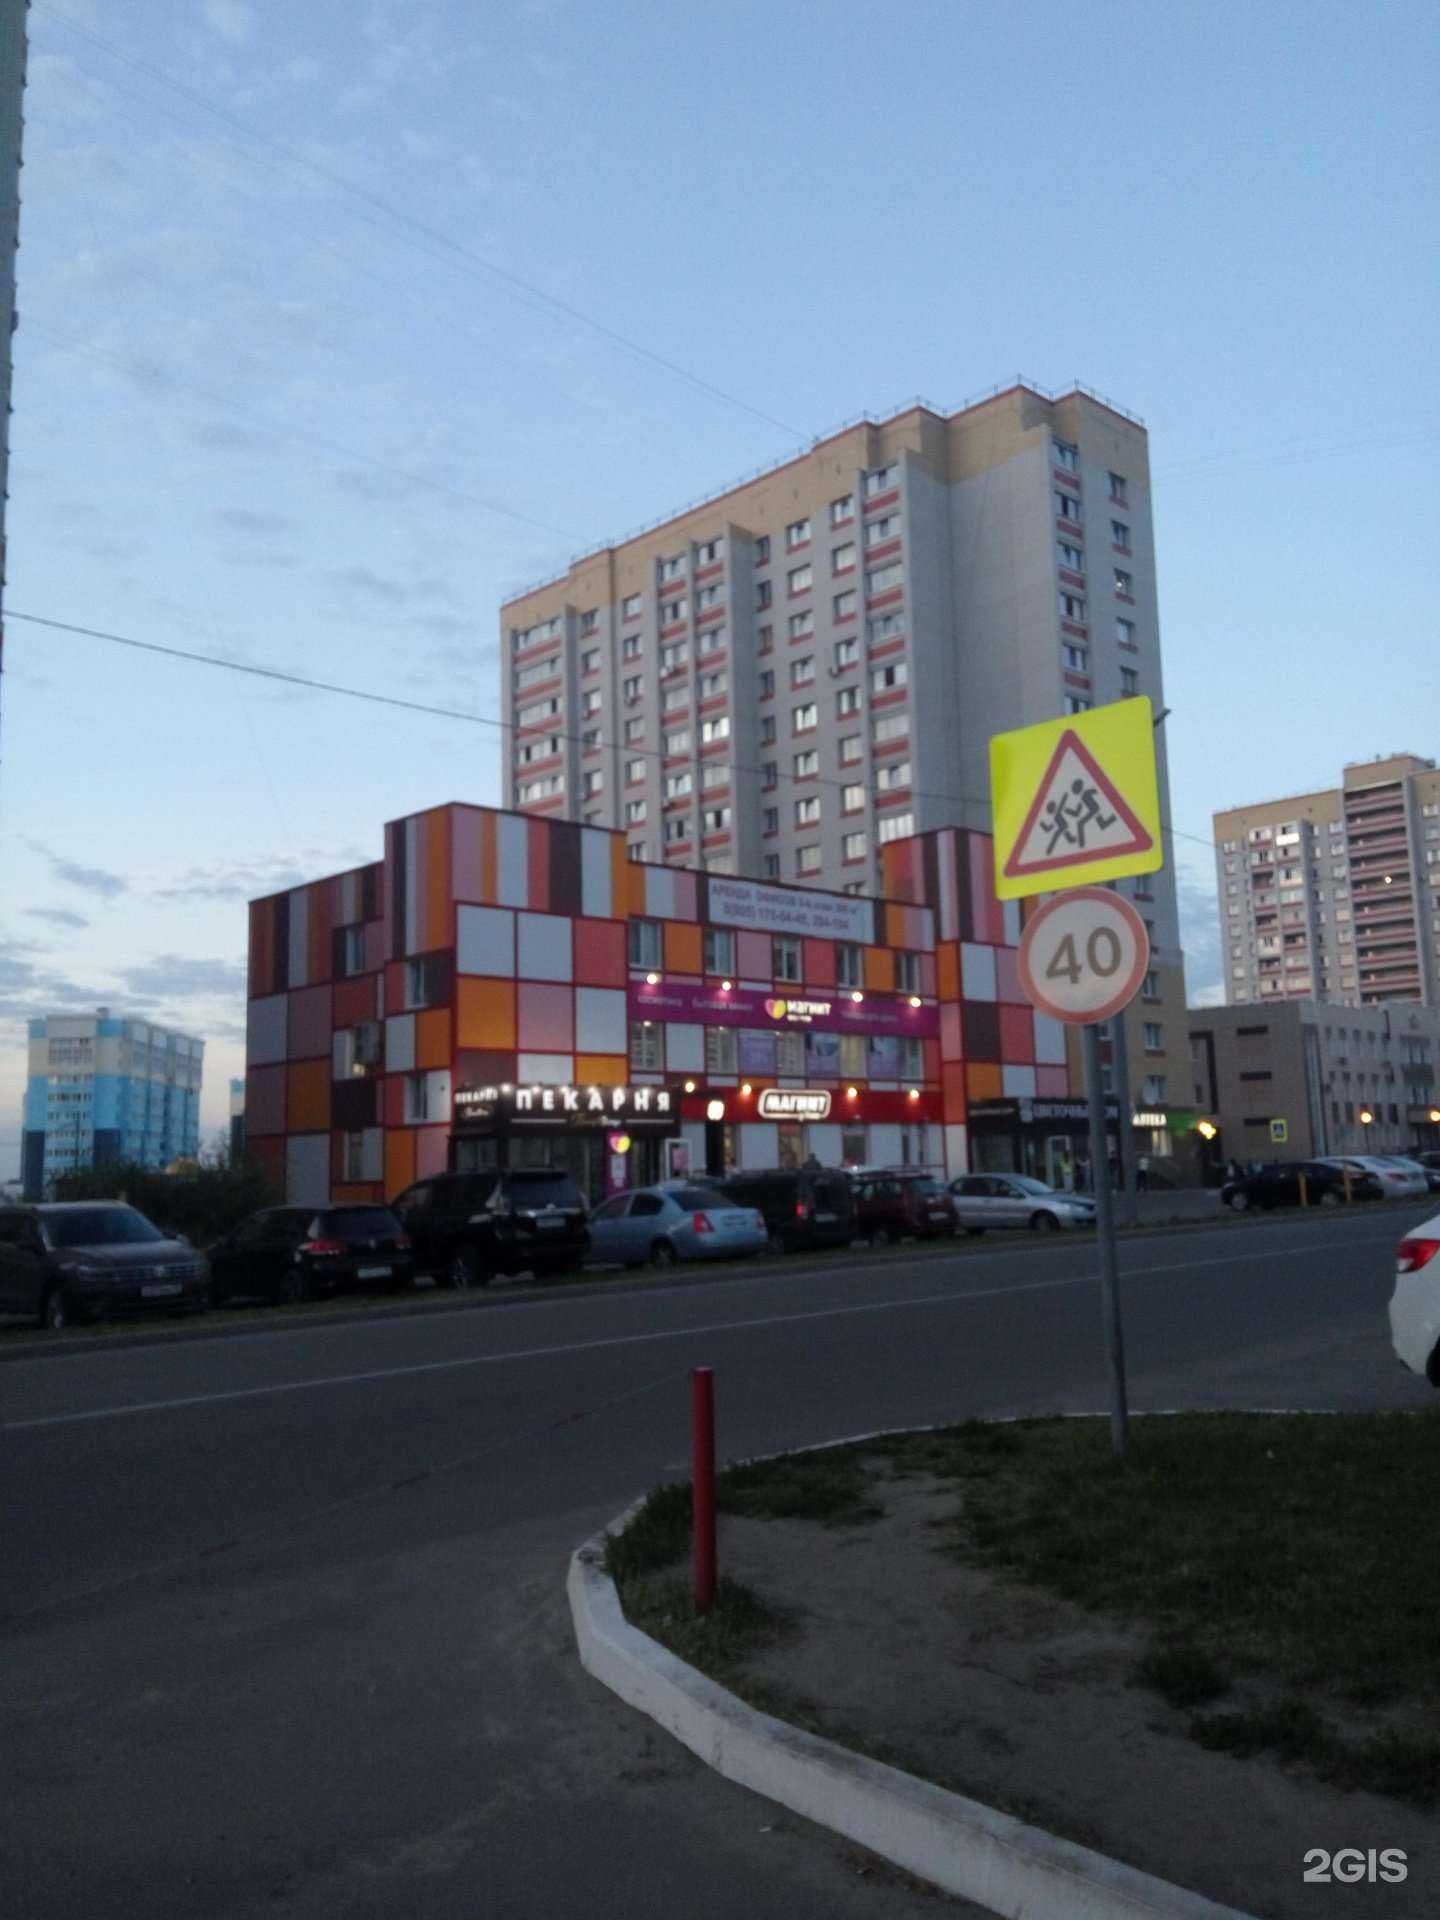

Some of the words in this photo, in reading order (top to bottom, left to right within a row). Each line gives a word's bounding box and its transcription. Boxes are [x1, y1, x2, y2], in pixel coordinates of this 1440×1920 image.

[1046, 926, 1122, 984] 40
[516, 1088, 670, 1111] ПЕКАРНЯ
[766, 1094, 827, 1113] МАГНИТ
